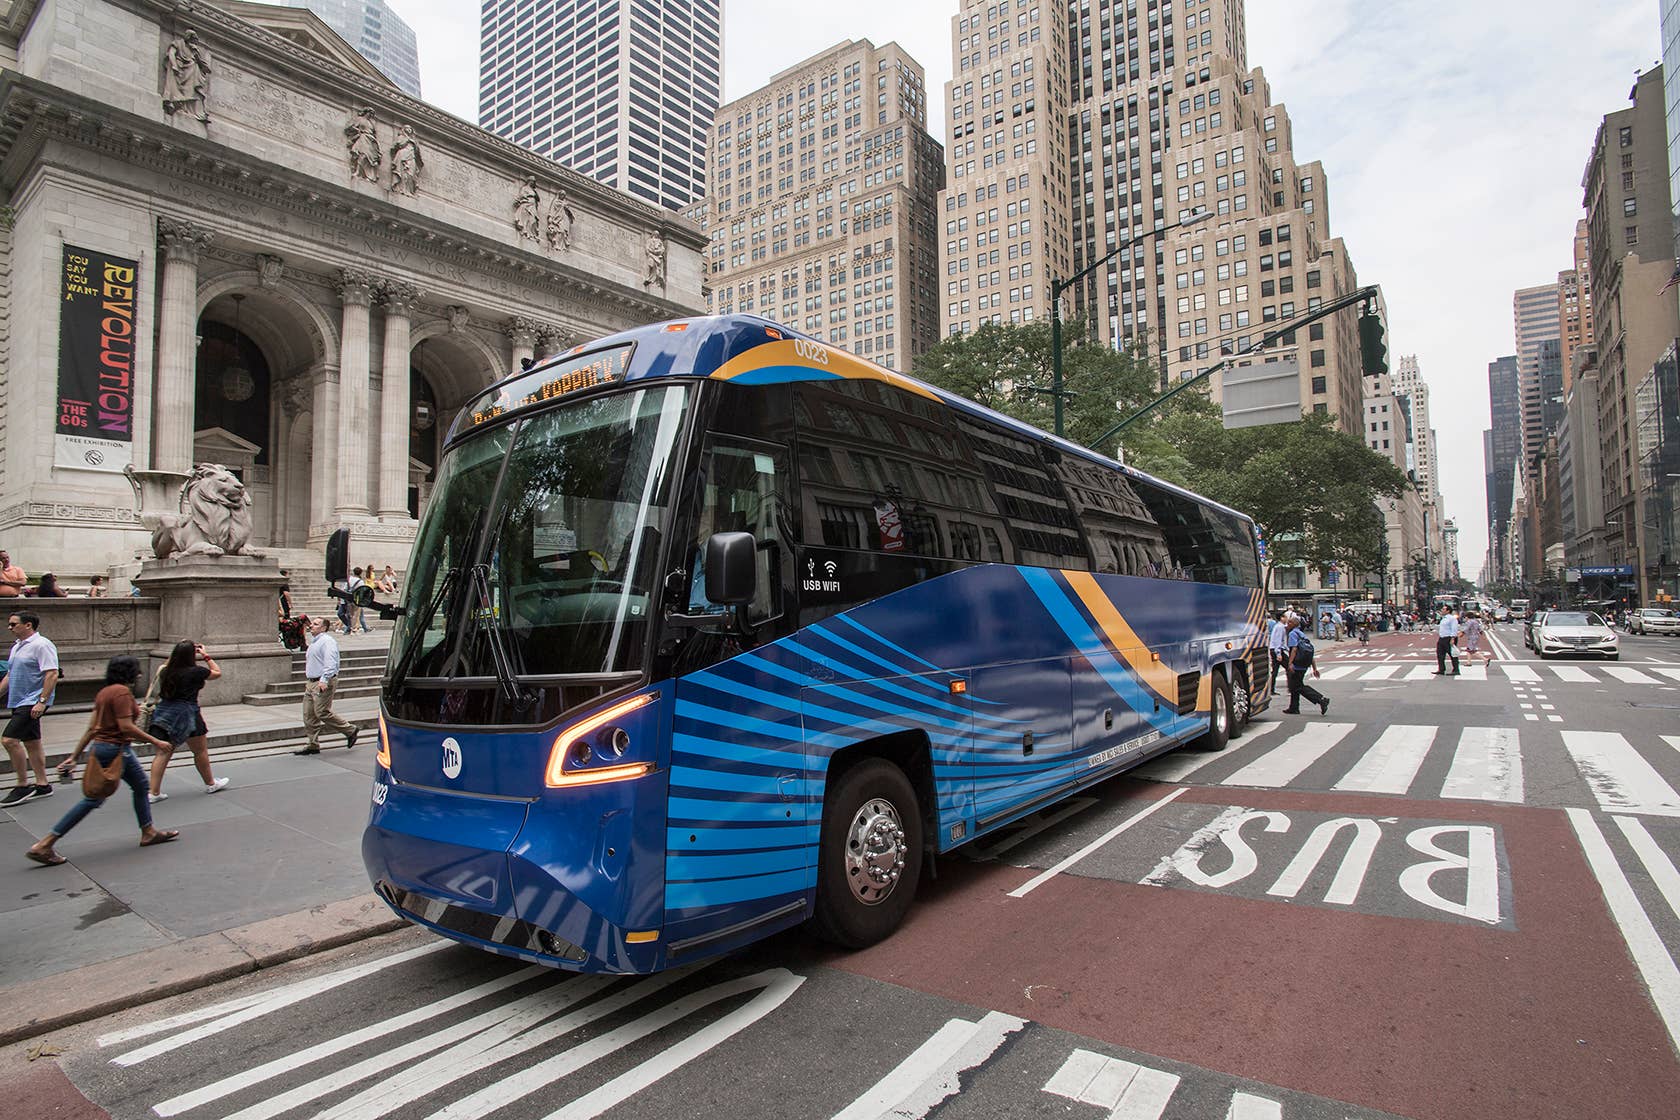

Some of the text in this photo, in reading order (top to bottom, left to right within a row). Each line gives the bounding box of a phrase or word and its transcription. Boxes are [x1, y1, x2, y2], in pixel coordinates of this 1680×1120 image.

[67, 254, 89, 265] YOU
[66, 263, 87, 274] SAY
[308, 223, 599, 322] THE NEW YORK PUBLIC LIBRARY
[66, 273, 88, 285] YOU
[66, 282, 99, 297] WANT
[65, 293, 74, 302] A
[98, 261, 134, 433] REVOLUTION
[794, 338, 829, 365] 0023
[61, 403, 88, 417] THE
[60, 414, 88, 428] 60s
[84, 439, 124, 449] EXHIBITION
[803, 579, 841, 592] USB WIFI
[1172, 810, 1500, 924] BUS
